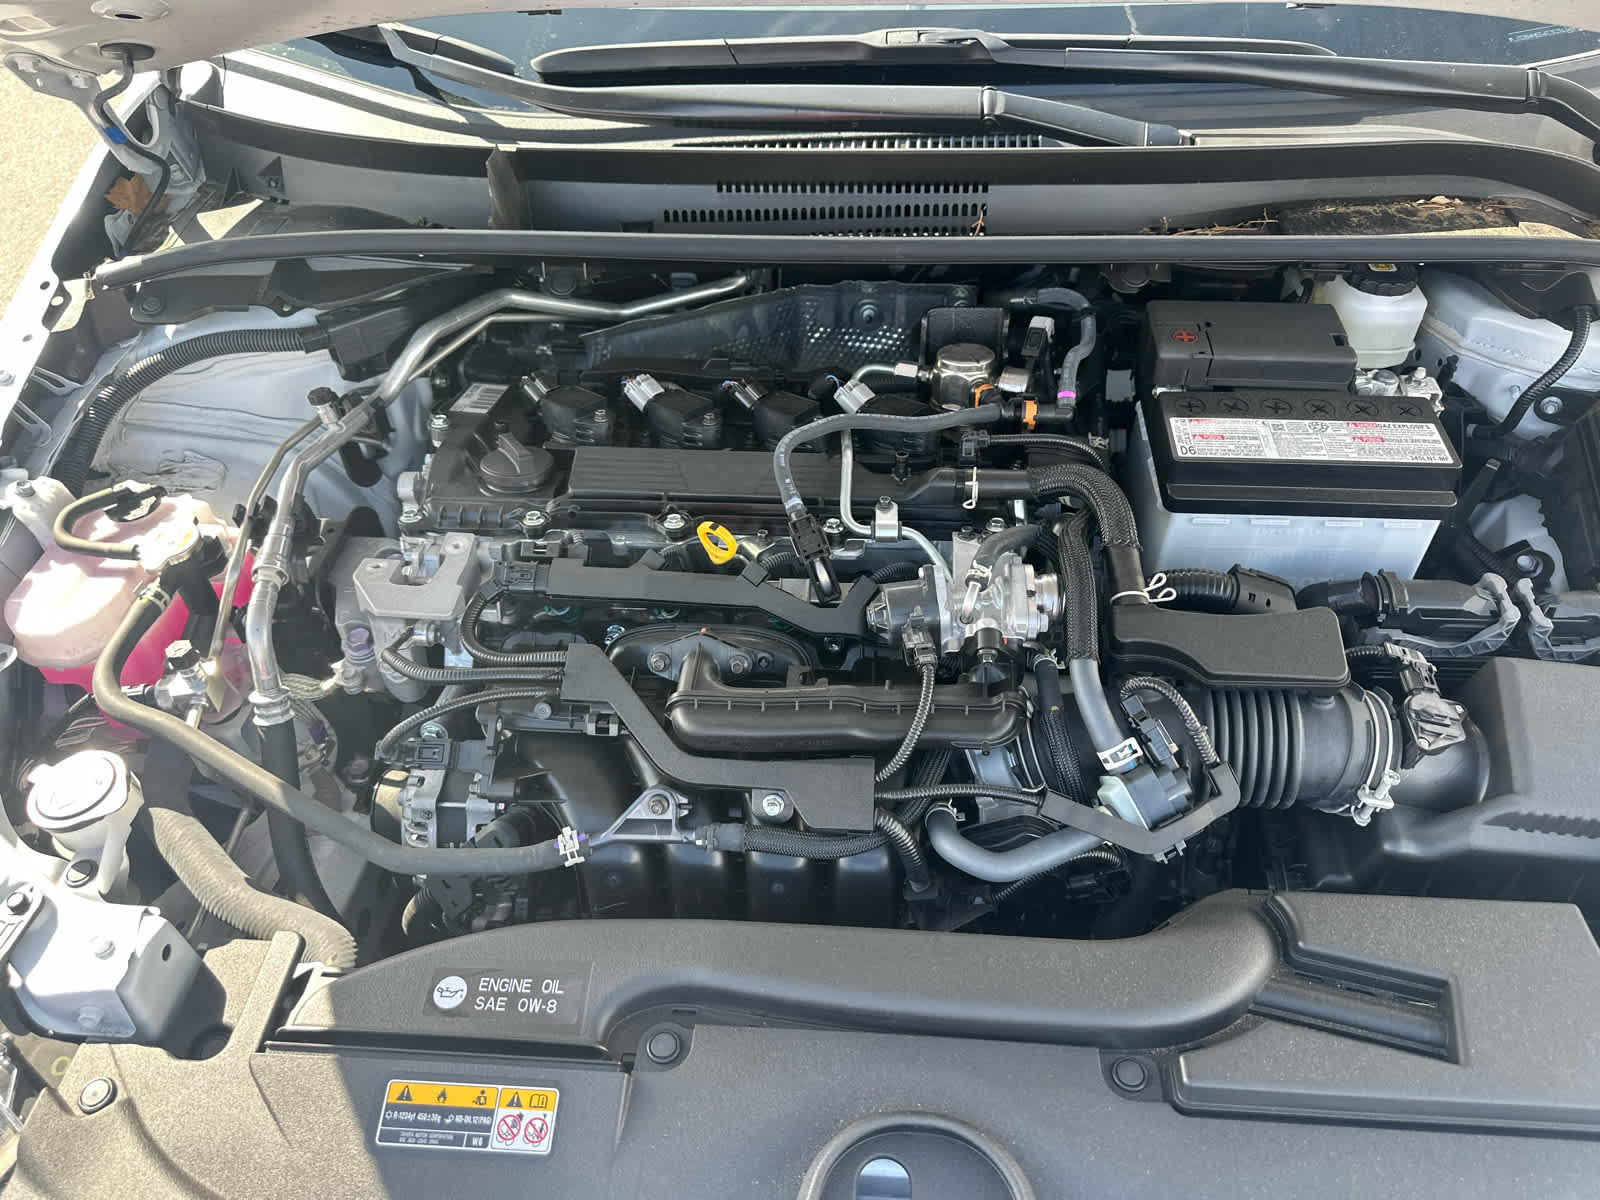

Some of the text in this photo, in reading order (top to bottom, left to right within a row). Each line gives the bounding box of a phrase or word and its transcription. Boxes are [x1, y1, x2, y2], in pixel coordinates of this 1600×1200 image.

[1180, 446, 1197, 456] D6
[478, 977, 565, 995] ENGINE OIL
[473, 996, 558, 1014] SAE 0W-8
